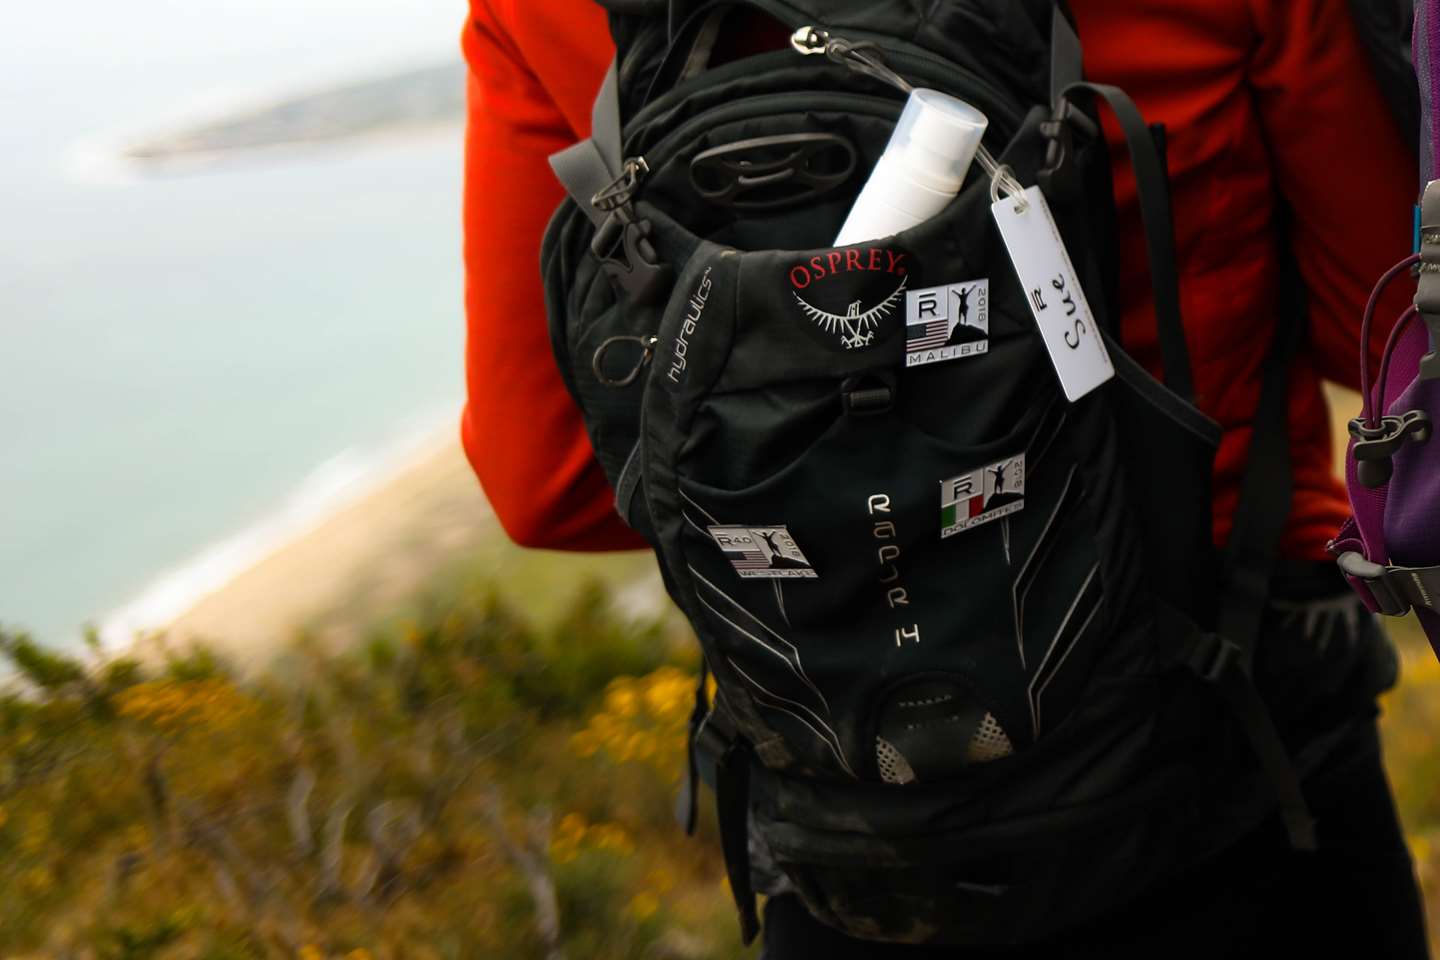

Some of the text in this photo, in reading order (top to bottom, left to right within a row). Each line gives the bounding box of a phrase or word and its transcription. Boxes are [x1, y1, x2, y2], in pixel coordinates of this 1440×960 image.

[790, 247, 905, 289] OSPREY
[667, 272, 712, 383] hydraulics
[1051, 273, 1087, 350] Sue
[909, 342, 987, 365] MALIBU
[895, 623, 920, 648] 14
